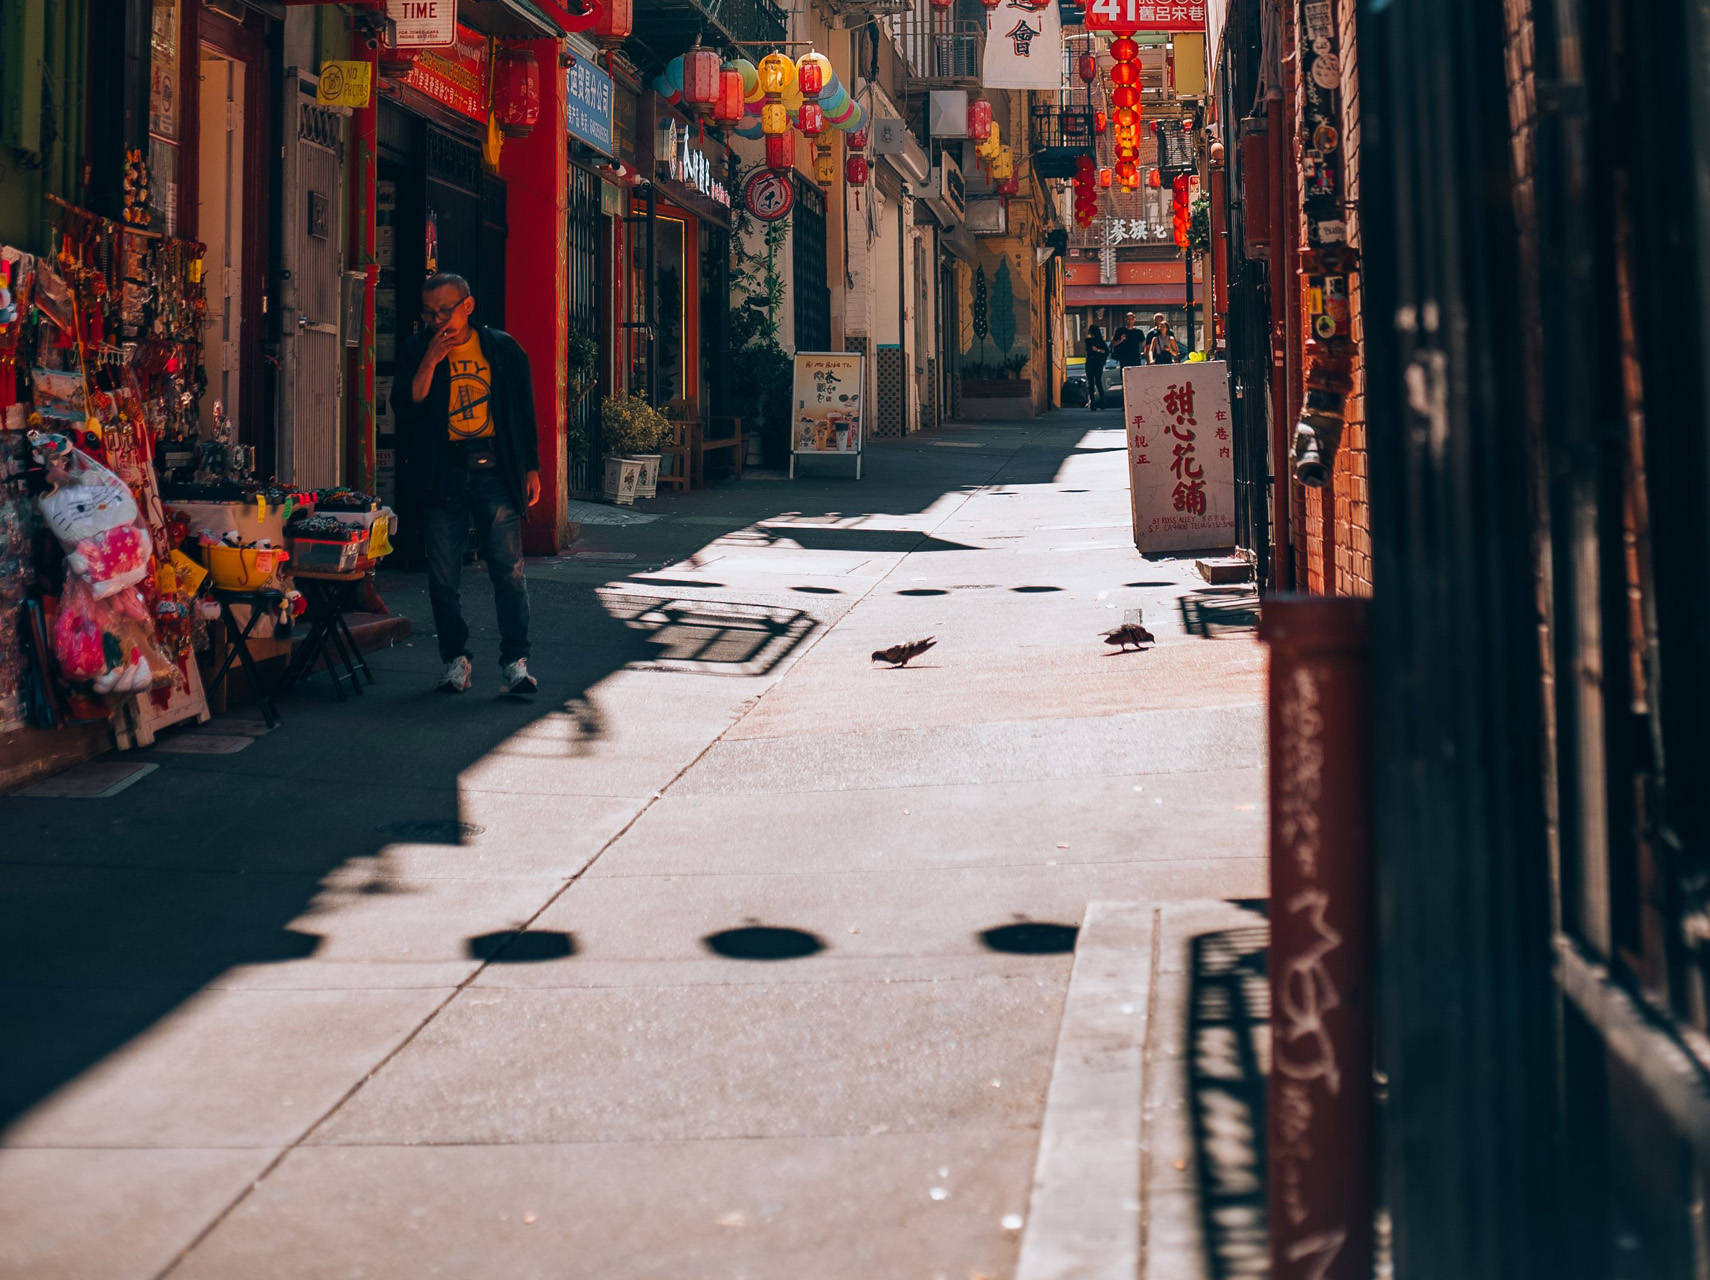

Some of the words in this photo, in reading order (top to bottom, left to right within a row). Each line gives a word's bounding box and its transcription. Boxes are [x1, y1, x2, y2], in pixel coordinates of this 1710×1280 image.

[402, 2, 438, 19] TIME
[345, 67, 358, 80] NO
[344, 83, 369, 98] PHOTOS
[1161, 516, 1177, 524] ROSS
